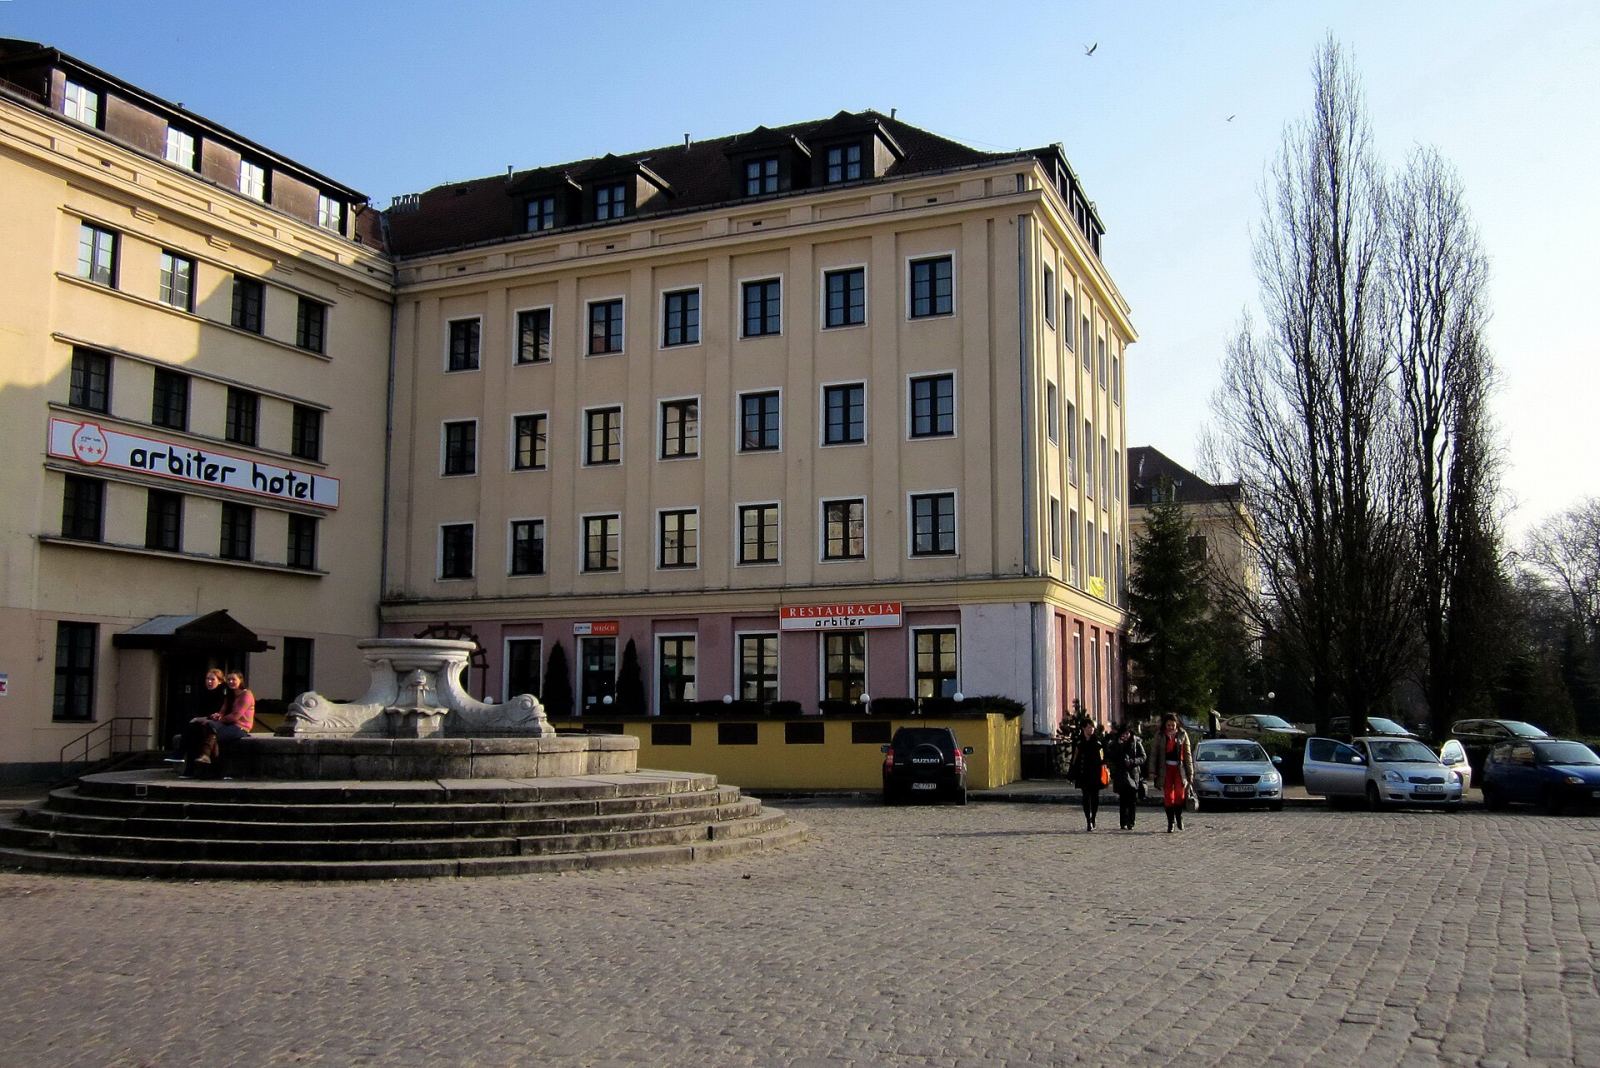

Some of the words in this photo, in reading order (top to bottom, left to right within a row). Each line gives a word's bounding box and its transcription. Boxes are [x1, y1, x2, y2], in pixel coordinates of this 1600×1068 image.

[130, 446, 237, 483] arbiter
[252, 462, 315, 501] hotel
[789, 603, 894, 617] RESTAURACJA
[815, 616, 865, 627] arbiter
